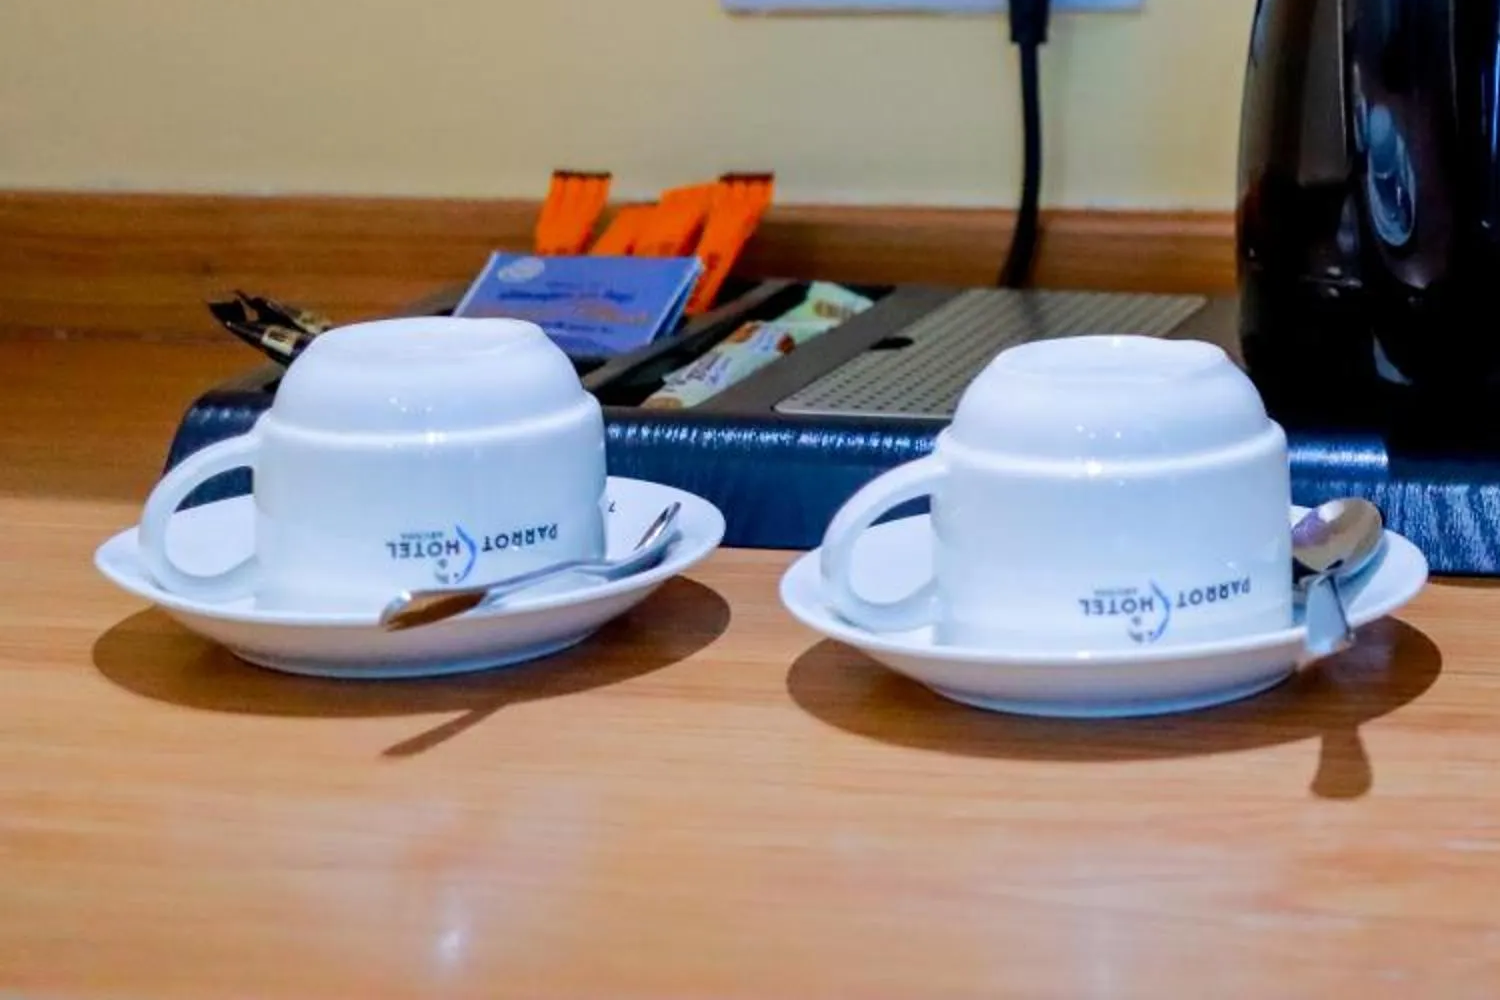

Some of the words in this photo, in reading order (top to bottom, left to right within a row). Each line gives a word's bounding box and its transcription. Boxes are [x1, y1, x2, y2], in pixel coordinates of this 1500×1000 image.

[386, 540, 460, 559] HOTEL
[482, 524, 558, 552] PARROT
[1177, 577, 1251, 607] PARROT
[1079, 598, 1154, 616] HOTEL
